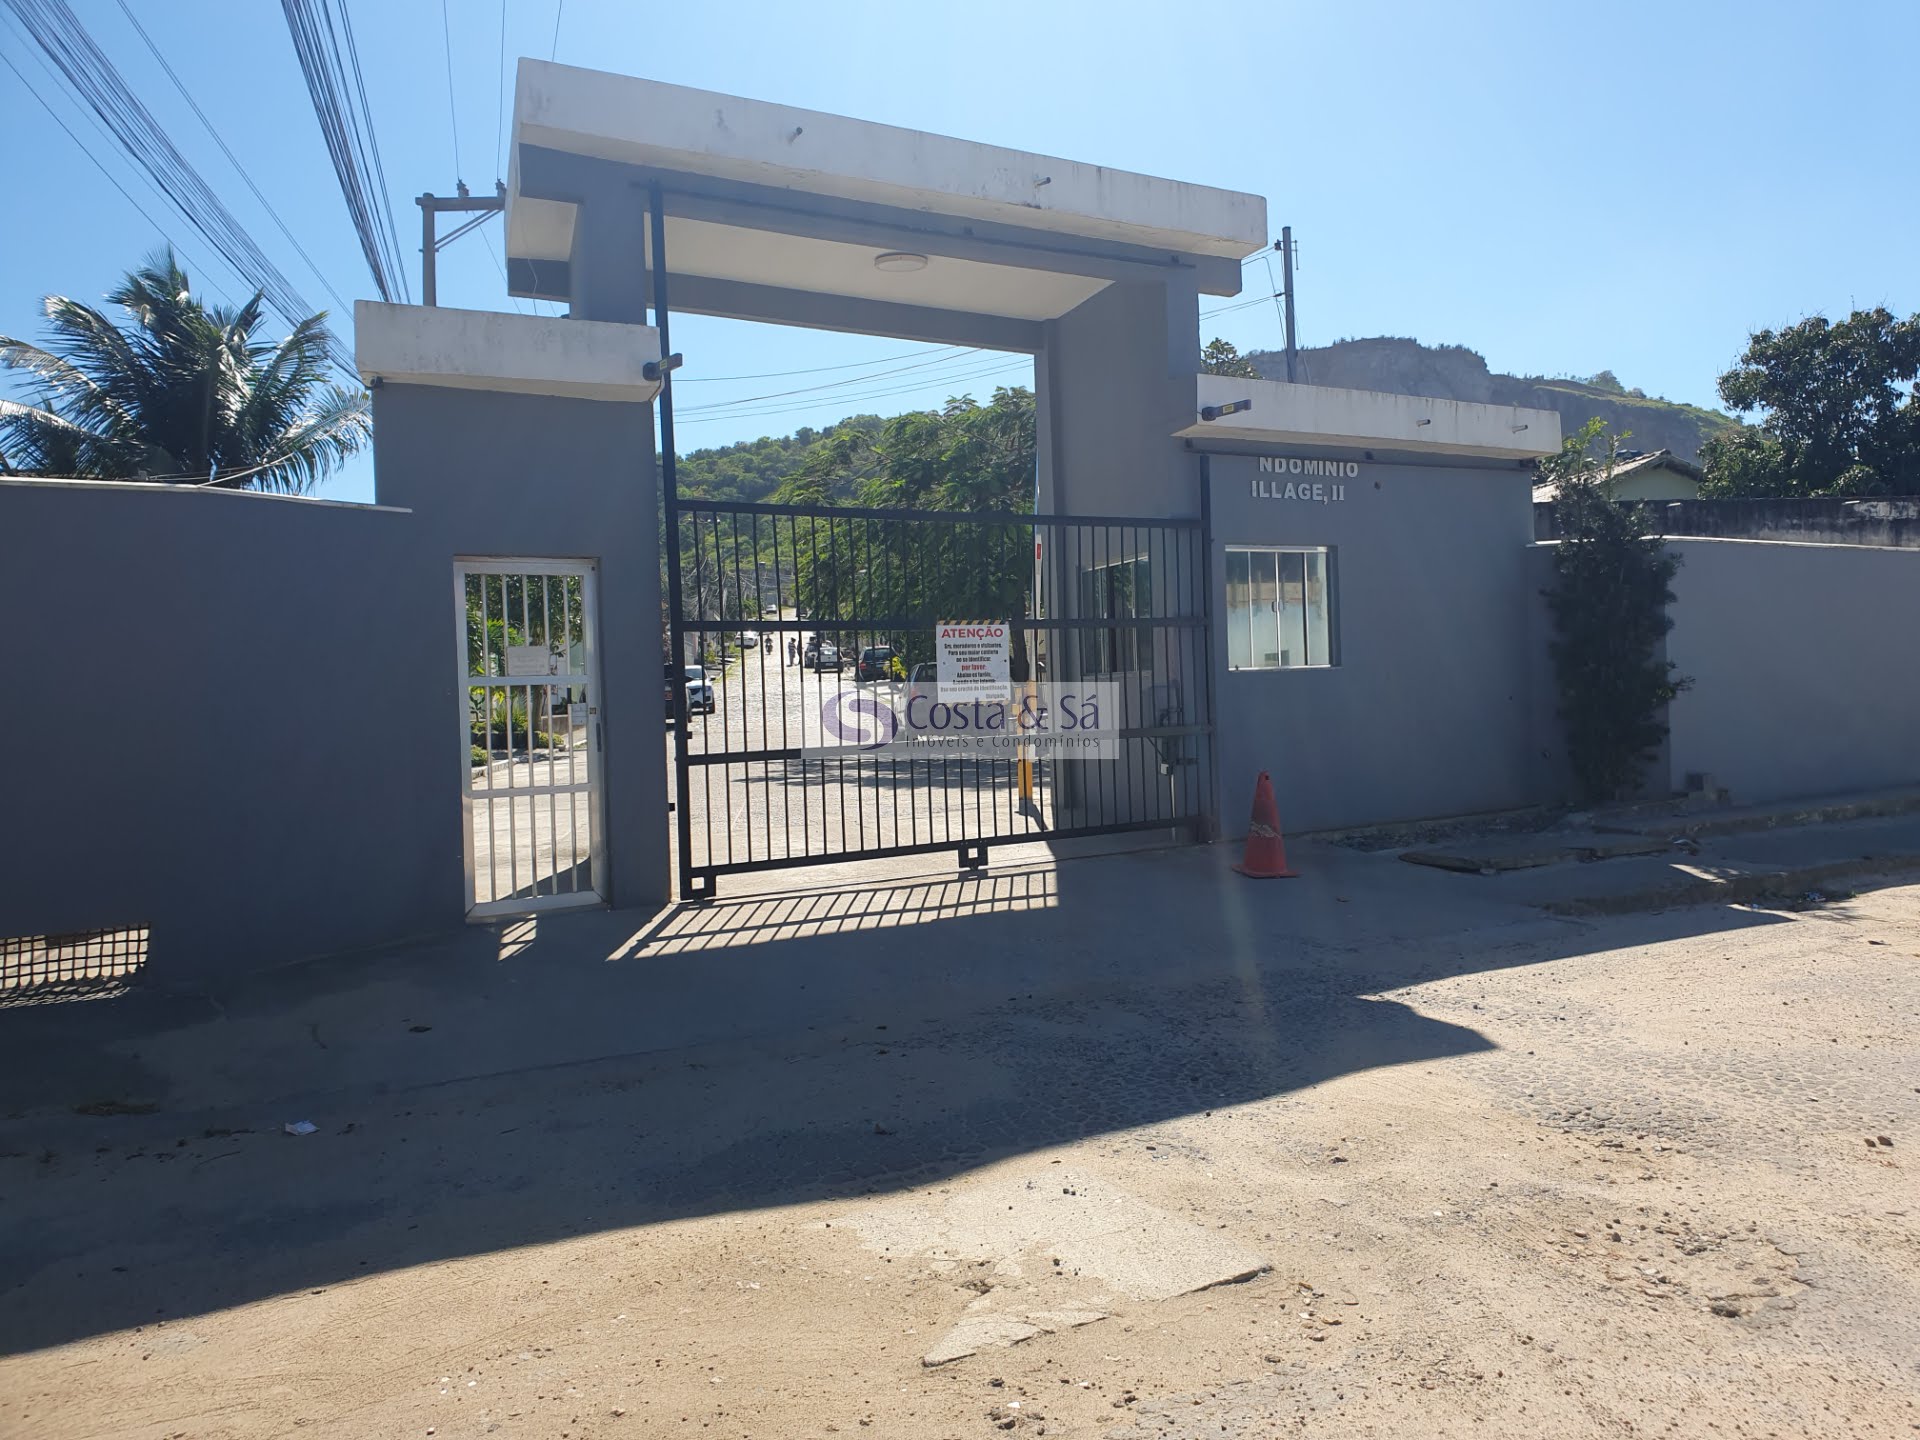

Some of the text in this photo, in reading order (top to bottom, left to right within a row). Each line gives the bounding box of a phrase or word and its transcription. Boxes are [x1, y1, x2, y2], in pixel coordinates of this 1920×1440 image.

[1259, 457, 1359, 477] NDOMINIO
[1331, 485, 1345, 501] II
[941, 625, 1004, 640] ATENÇÃO
